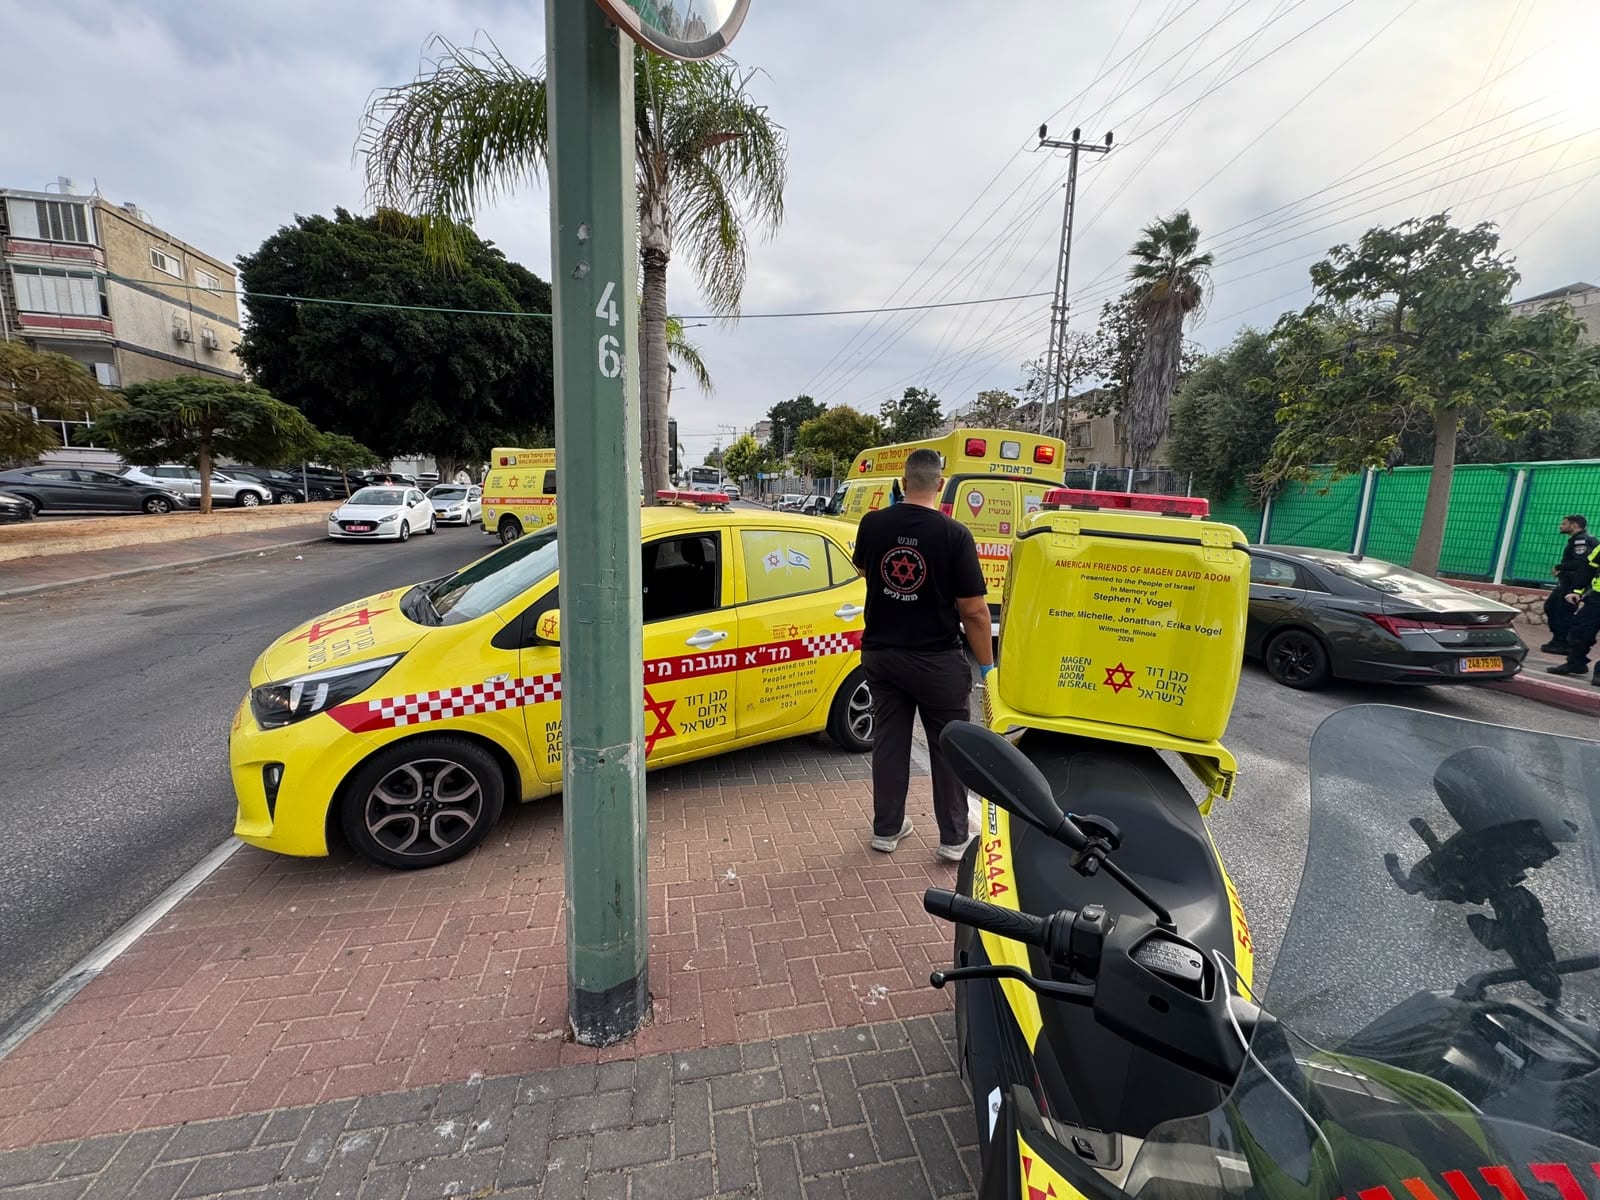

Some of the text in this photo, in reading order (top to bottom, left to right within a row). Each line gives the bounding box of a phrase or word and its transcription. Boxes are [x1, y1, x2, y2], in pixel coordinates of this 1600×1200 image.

[989, 463, 1033, 475] פראמדיק
[897, 536, 918, 546] חובש
[1055, 560, 1231, 583] AMERICAN FRIENDS OF MAGEN DAVID ADOM
[1080, 574, 1113, 583] Presented
[1124, 577, 1136, 585] the
[1137, 579, 1162, 588] People
[1173, 583, 1195, 591] Israel
[883, 587, 918, 602] מרחב לכיש
[1118, 587, 1148, 596] Memory
[1093, 592, 1172, 609] Stephen N. Vogel
[1077, 610, 1115, 622] Michelle,
[1118, 615, 1164, 629] Jonathan,
[1166, 620, 1191, 631] Erika
[1194, 625, 1222, 637] Vogel
[1098, 625, 1157, 637] Wilmette, Illinois
[1117, 635, 1135, 643] 2026
[681, 653, 737, 673] תגובה
[745, 646, 790, 665] מד"א
[1061, 656, 1092, 666] MAGEN
[761, 663, 797, 674] Presented
[763, 668, 816, 684] People of Israel
[1059, 672, 1084, 681] ADOM
[1060, 664, 1085, 673] DAVID
[1145, 666, 1189, 683] מגן דוד
[765, 679, 813, 694] By Anonymous
[1057, 680, 1097, 691] IN ISRAEL
[1156, 679, 1187, 695] אדום
[684, 690, 728, 707] מגן דוד
[760, 687, 818, 704] Glenview, Illinois
[1137, 686, 1184, 706] בישראל
[698, 702, 728, 718] אדום
[780, 700, 797, 709] 2024
[680, 715, 727, 734] בישראל
[984, 838, 1009, 897] 5444
